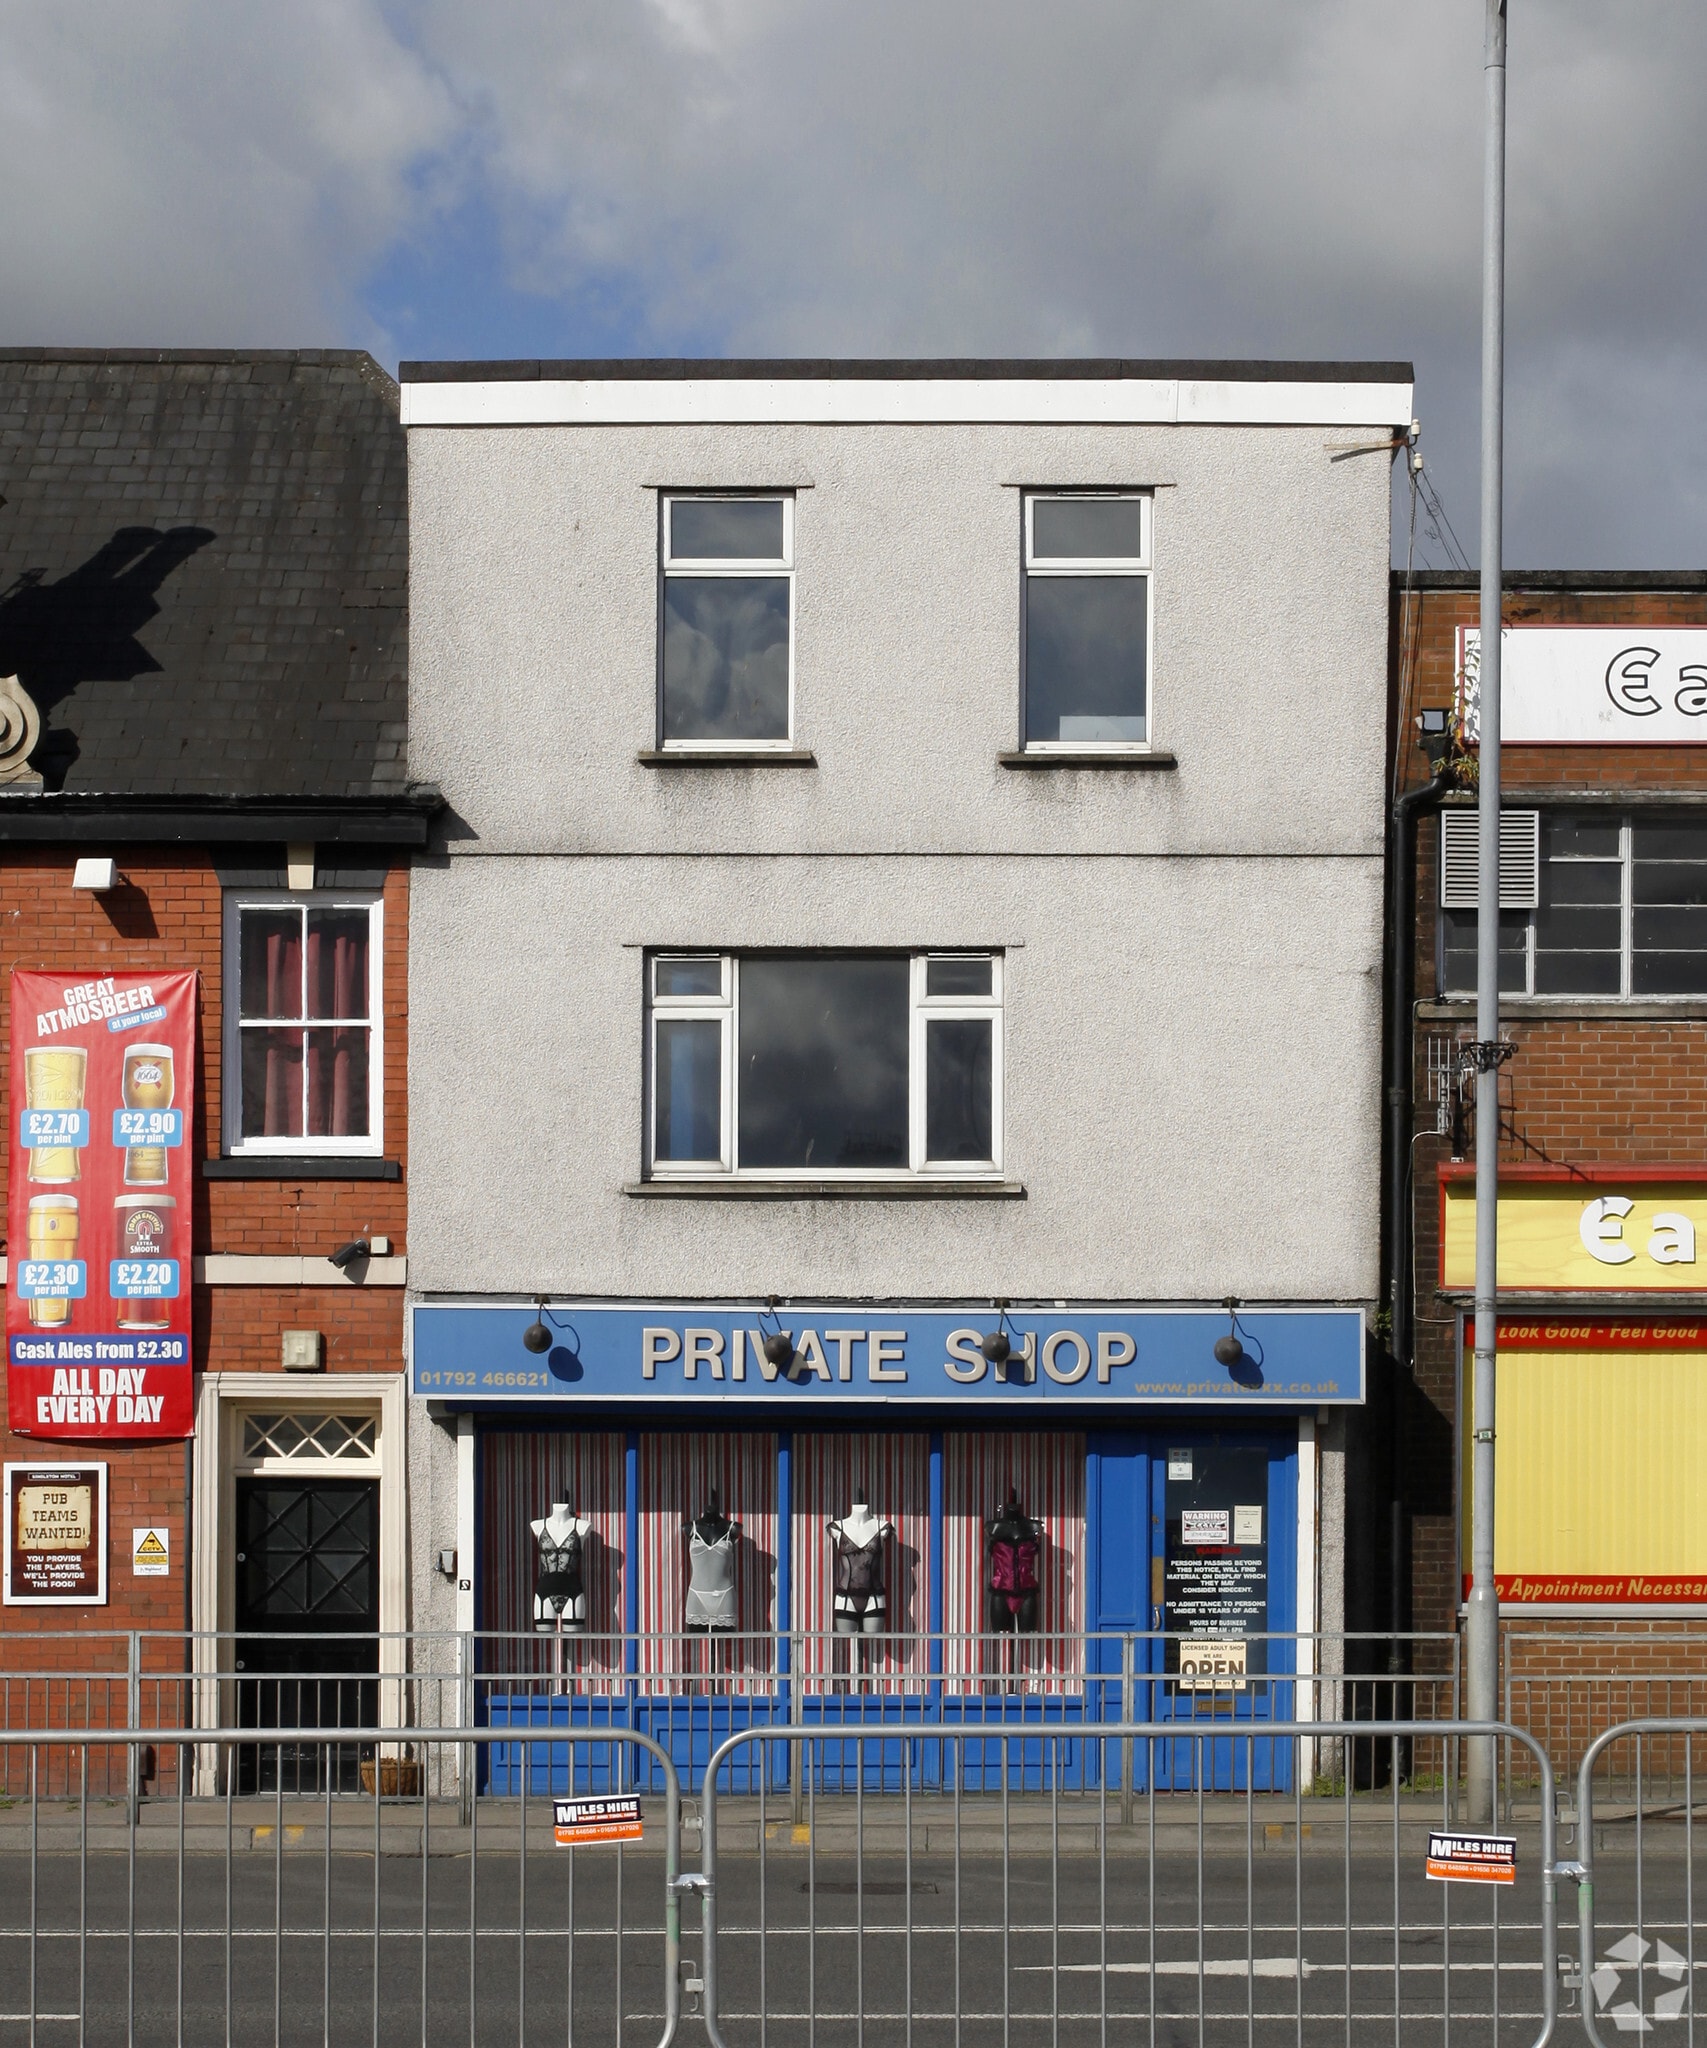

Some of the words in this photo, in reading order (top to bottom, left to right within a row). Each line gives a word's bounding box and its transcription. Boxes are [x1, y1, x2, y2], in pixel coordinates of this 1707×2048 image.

[63, 977, 115, 1006] GREAT
[36, 985, 155, 1037] ATMOSBEER
[112, 1020, 122, 1030] at
[123, 1016, 141, 1029] your
[142, 1008, 163, 1025] local
[29, 1113, 80, 1134] £2.70
[121, 1113, 175, 1134] £2.90
[37, 1135, 52, 1145] per
[54, 1133, 71, 1145] pint
[130, 1135, 146, 1145] per
[148, 1134, 165, 1145] pint
[130, 1246, 160, 1254] SMOOTH
[25, 1264, 79, 1285] £2.30
[117, 1264, 171, 1285] £2.20
[34, 1286, 50, 1296] per
[52, 1285, 69, 1296] pint
[127, 1286, 144, 1296] per
[144, 1285, 162, 1296] pint
[1499, 1322, 1539, 1339] Look
[1544, 1321, 1590, 1339] Good
[1609, 1322, 1647, 1339] Feel
[1652, 1321, 1700, 1339] Good
[16, 1342, 55, 1359] Cask
[58, 1342, 93, 1359] Ales
[95, 1342, 134, 1359] from
[137, 1341, 183, 1359] £2.30
[642, 1327, 908, 1382] PRIVATE
[943, 1328, 1138, 1385] SHOP
[53, 1368, 93, 1396] ALL
[99, 1368, 147, 1396] DAY
[420, 1371, 476, 1386] 01792
[482, 1372, 548, 1387] 466621
[37, 1396, 112, 1424] EVERY
[117, 1396, 164, 1424] DAY
[43, 1494, 68, 1504] PUB
[33, 1510, 78, 1522] TEAMS
[25, 1528, 86, 1539] WANTED!
[1494, 1578, 1504, 1596] o
[1508, 1578, 1624, 1600] Appointment
[556, 1804, 604, 1822] MILES
[606, 1801, 637, 1812] HIRE
[1431, 1840, 1480, 1856] MILES
[1482, 1842, 1512, 1854] HIRE
